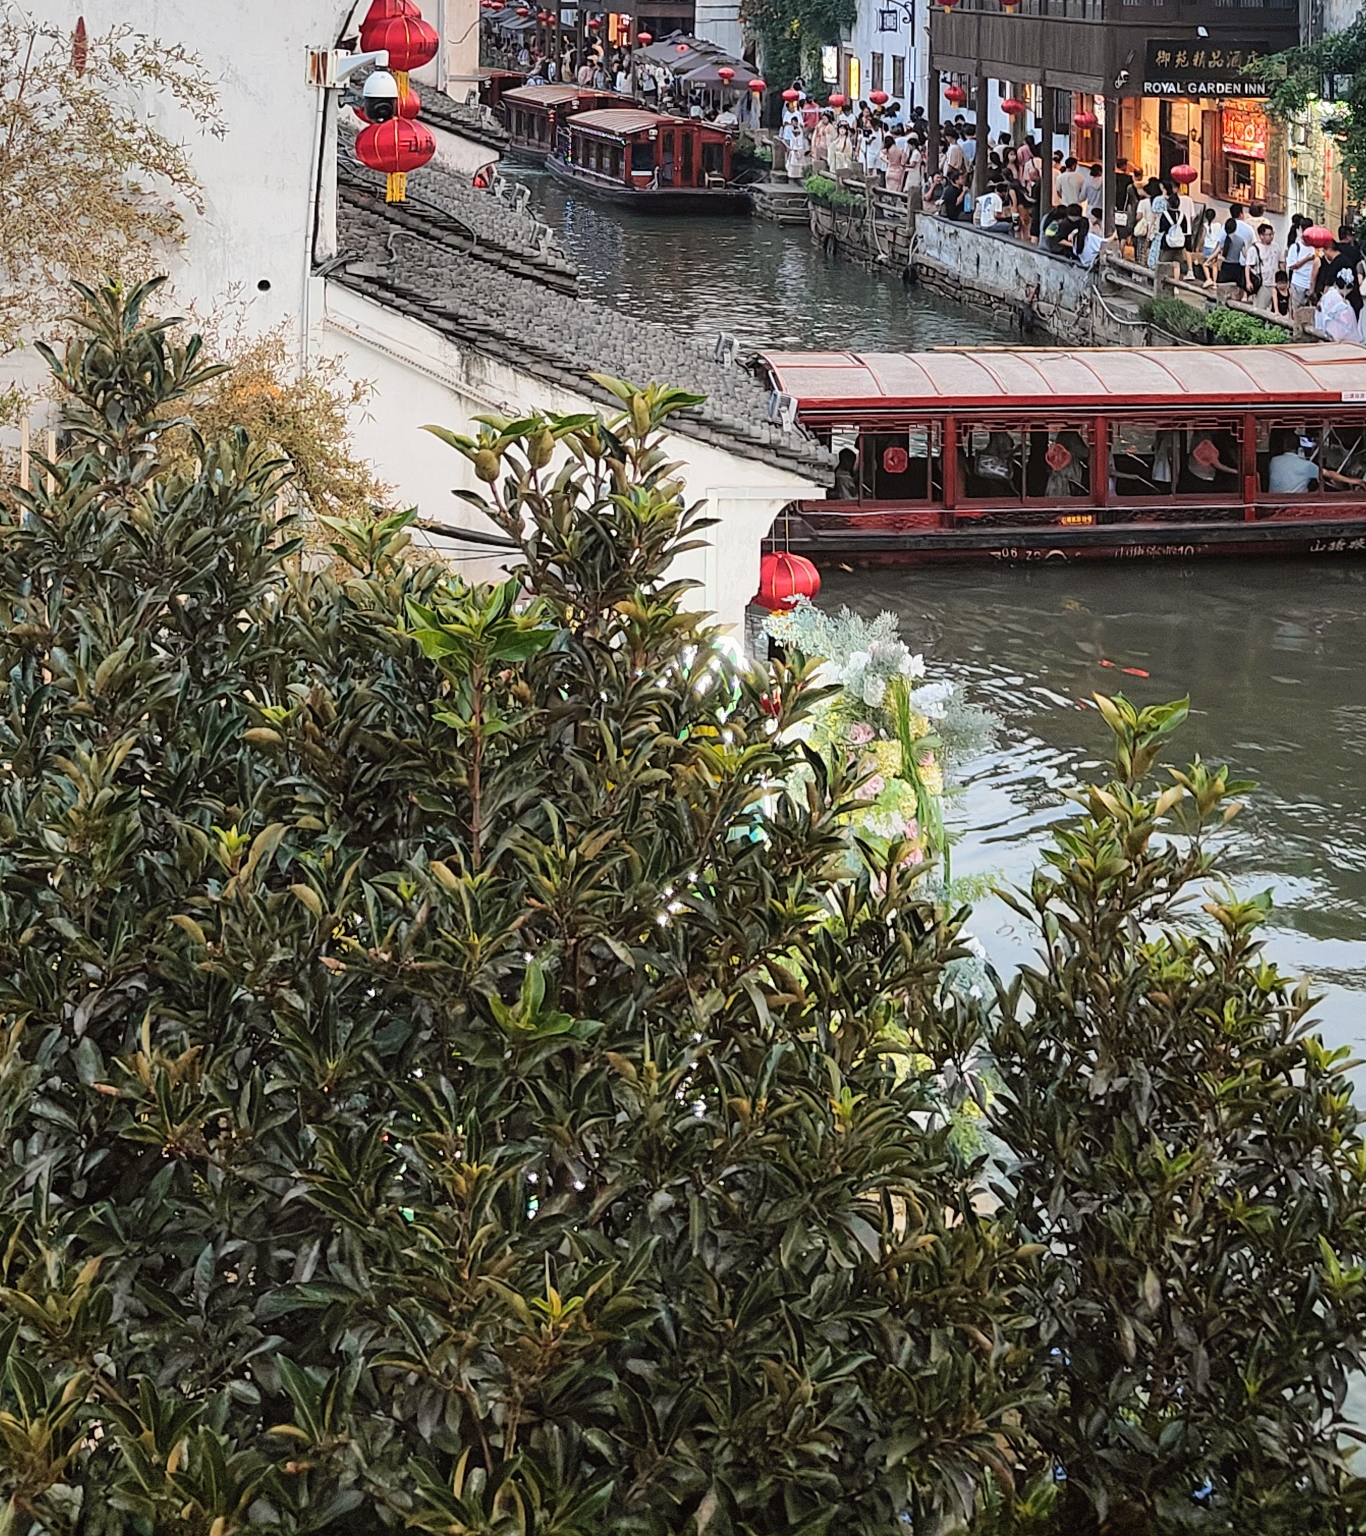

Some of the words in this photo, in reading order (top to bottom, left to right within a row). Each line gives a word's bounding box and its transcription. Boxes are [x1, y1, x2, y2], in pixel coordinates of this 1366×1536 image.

[1143, 82, 1185, 94] ROYAL
[1187, 82, 1242, 95] GARDEN
[1244, 82, 1267, 95] INN
